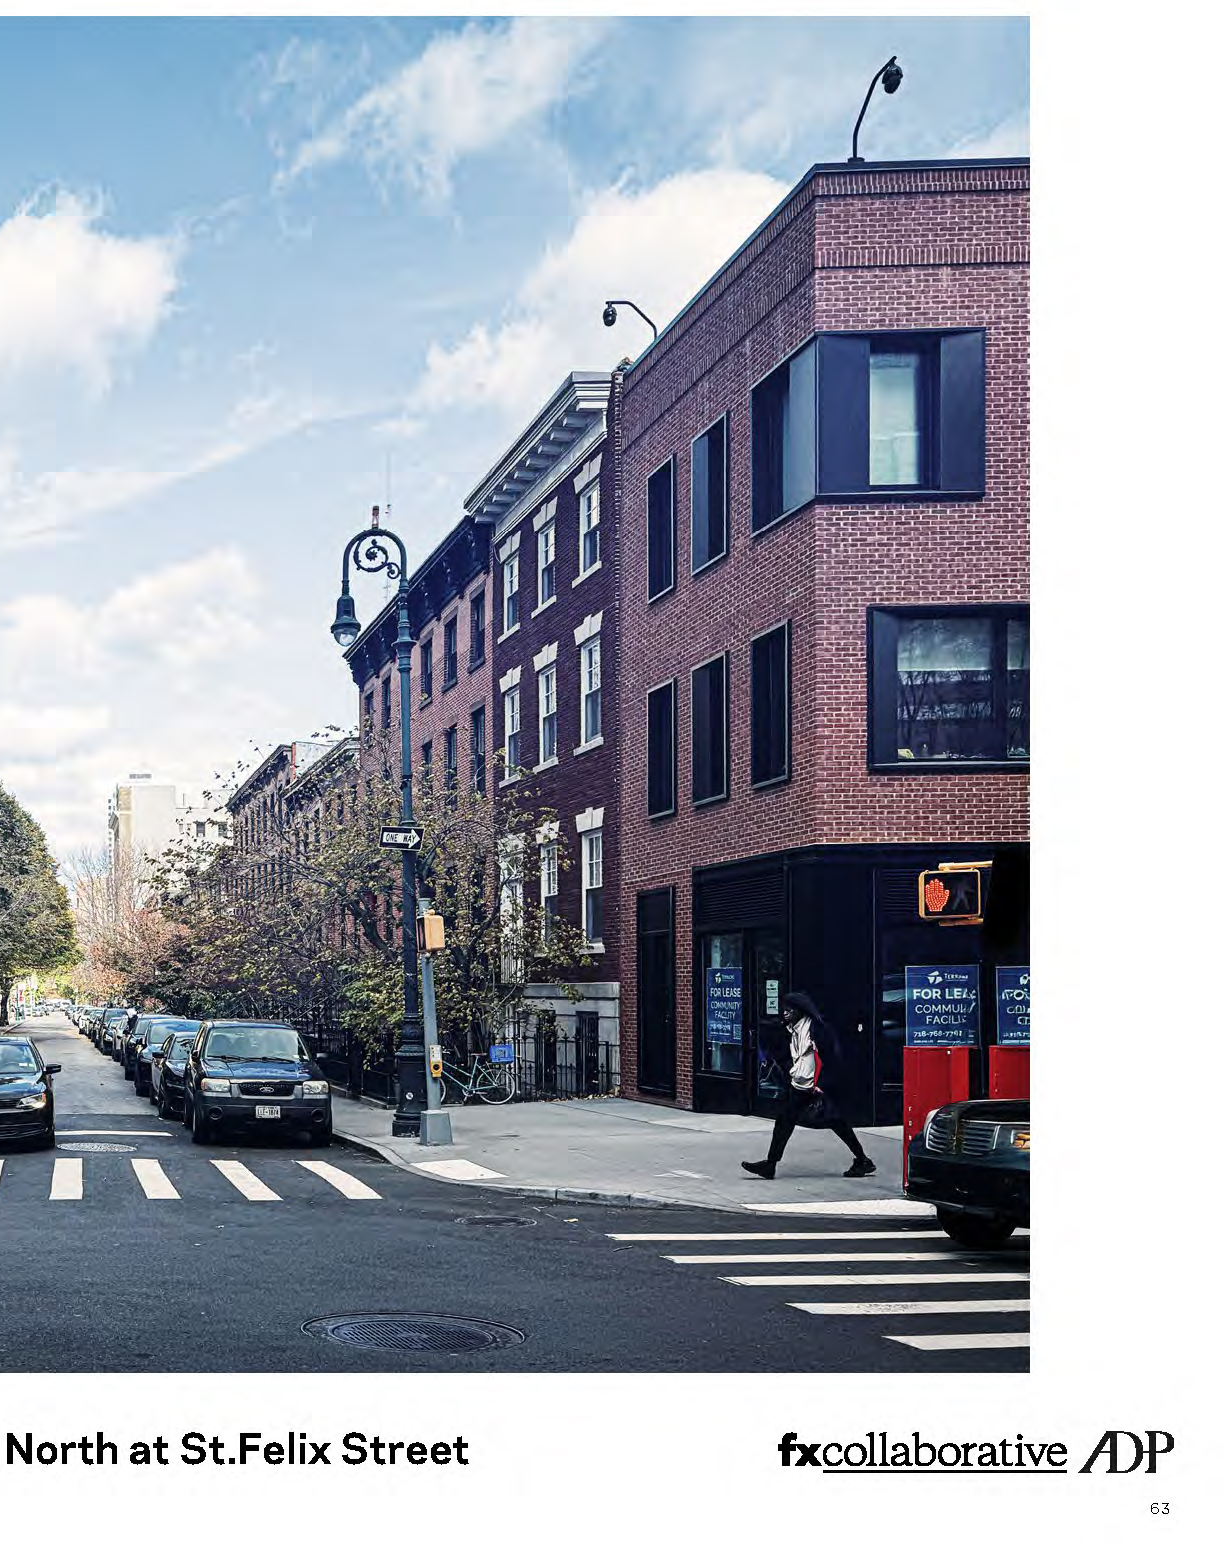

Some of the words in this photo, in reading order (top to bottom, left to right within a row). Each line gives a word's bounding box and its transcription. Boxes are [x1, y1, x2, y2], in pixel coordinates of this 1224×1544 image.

[386, 834, 398, 843] ONE
[403, 834, 417, 843] WAY
[710, 988, 721, 997] FOR
[723, 988, 741, 997] LEASE
[913, 989, 942, 1000] FOR
[710, 1002, 741, 1010] COMMUNITY
